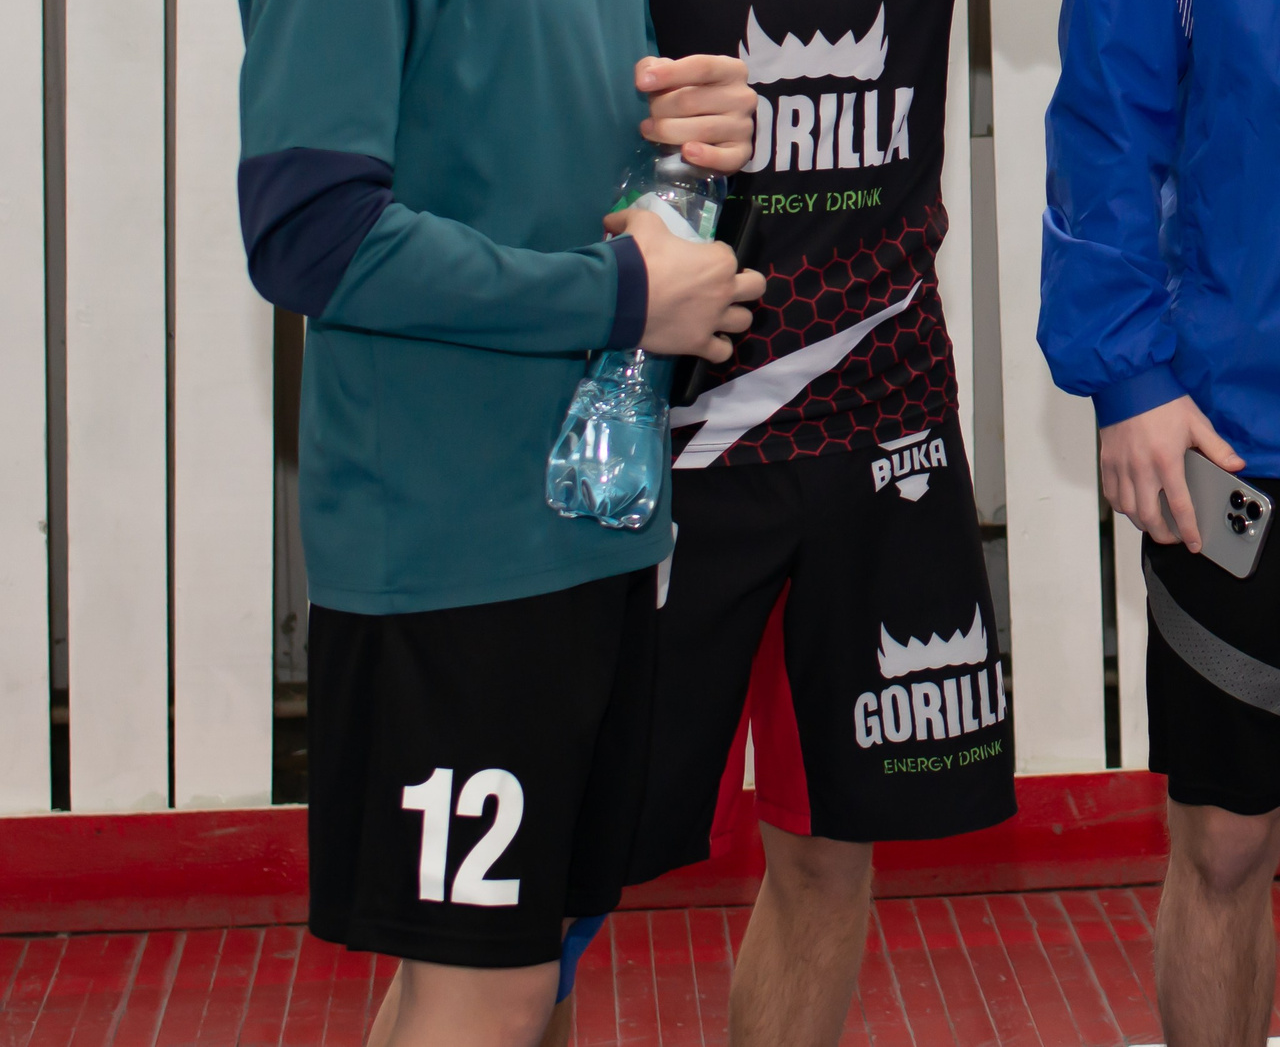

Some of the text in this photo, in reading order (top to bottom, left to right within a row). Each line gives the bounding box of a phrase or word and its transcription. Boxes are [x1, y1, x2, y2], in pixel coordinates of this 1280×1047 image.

[741, 87, 915, 173] ORILLA
[727, 187, 882, 214] ERGY DRINK
[871, 438, 948, 493] BUKA
[854, 660, 1008, 749] GORILLA
[884, 739, 1004, 774] ENERGY DRINK
[402, 768, 524, 906] 12
